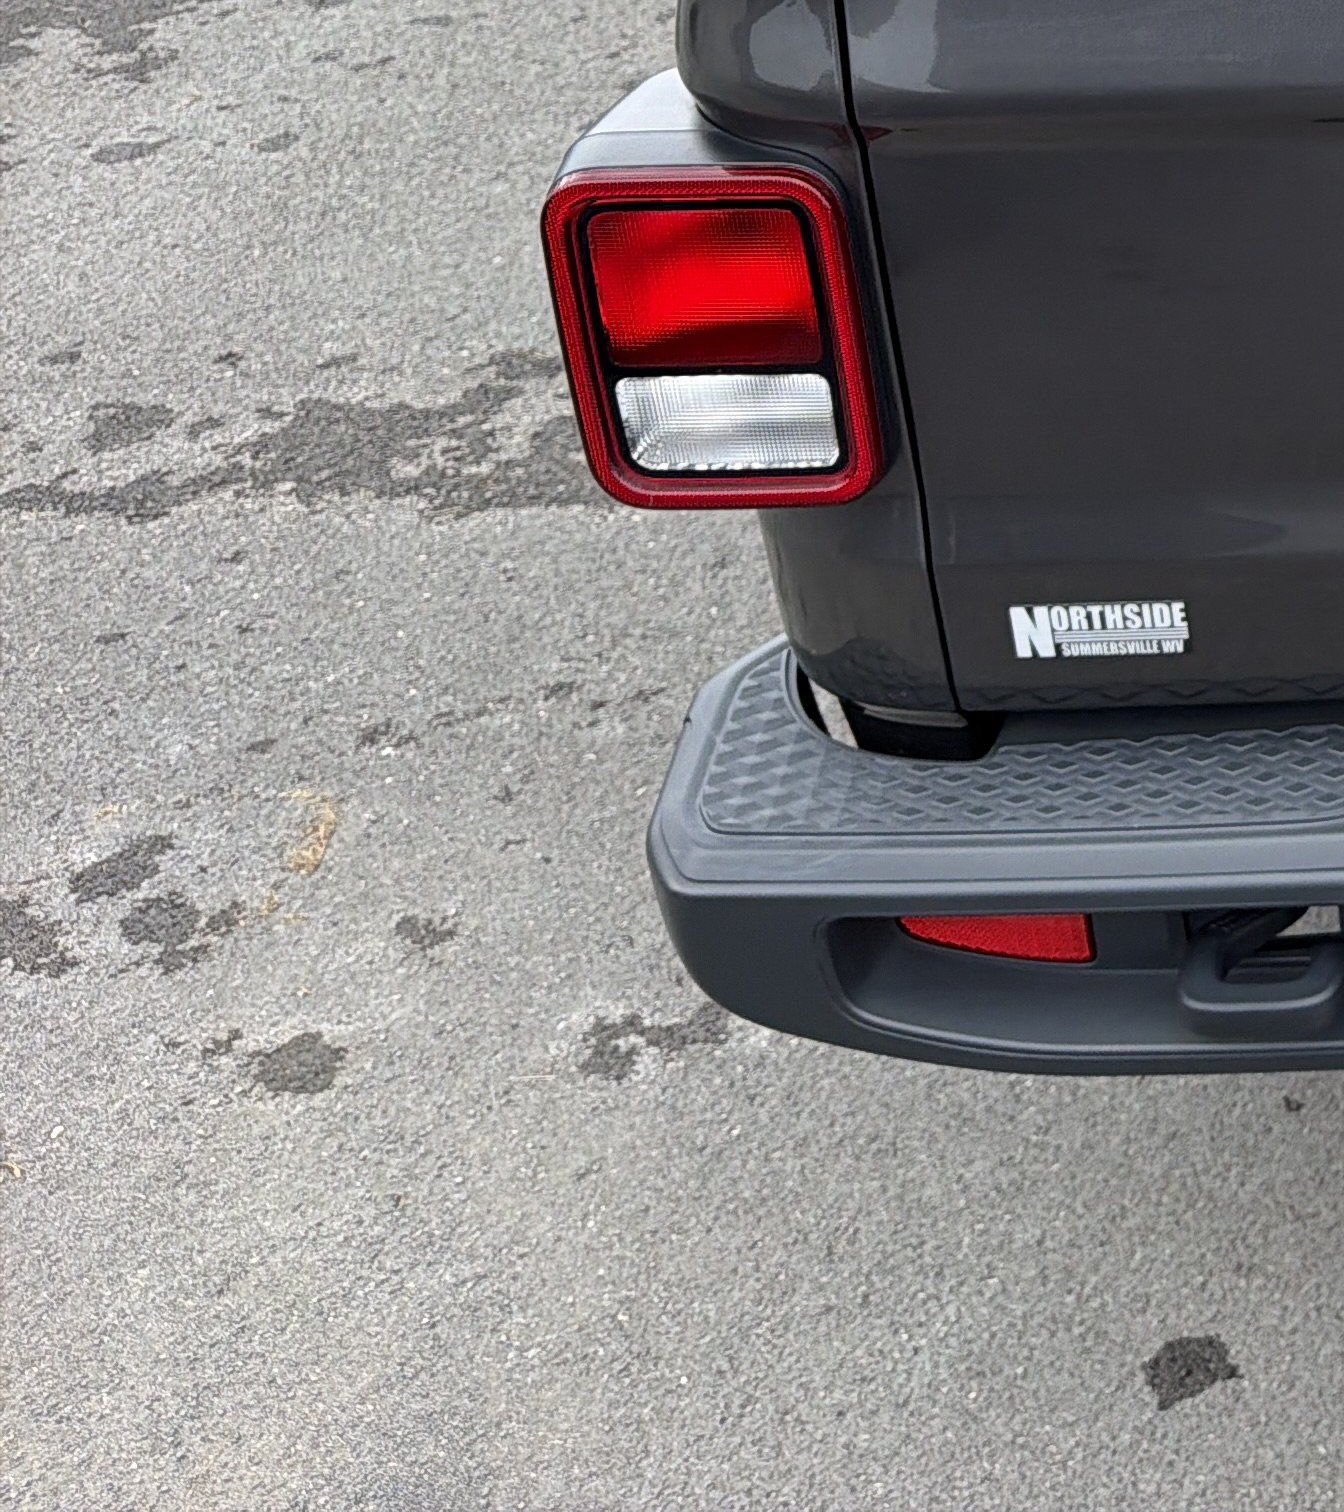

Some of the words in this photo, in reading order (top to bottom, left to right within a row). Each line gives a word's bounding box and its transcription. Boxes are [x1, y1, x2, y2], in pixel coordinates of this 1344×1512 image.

[1009, 601, 1189, 658] NORTHSIDE
[1061, 641, 1159, 657] SUMMERSVILLE
[1161, 639, 1184, 655] WV
